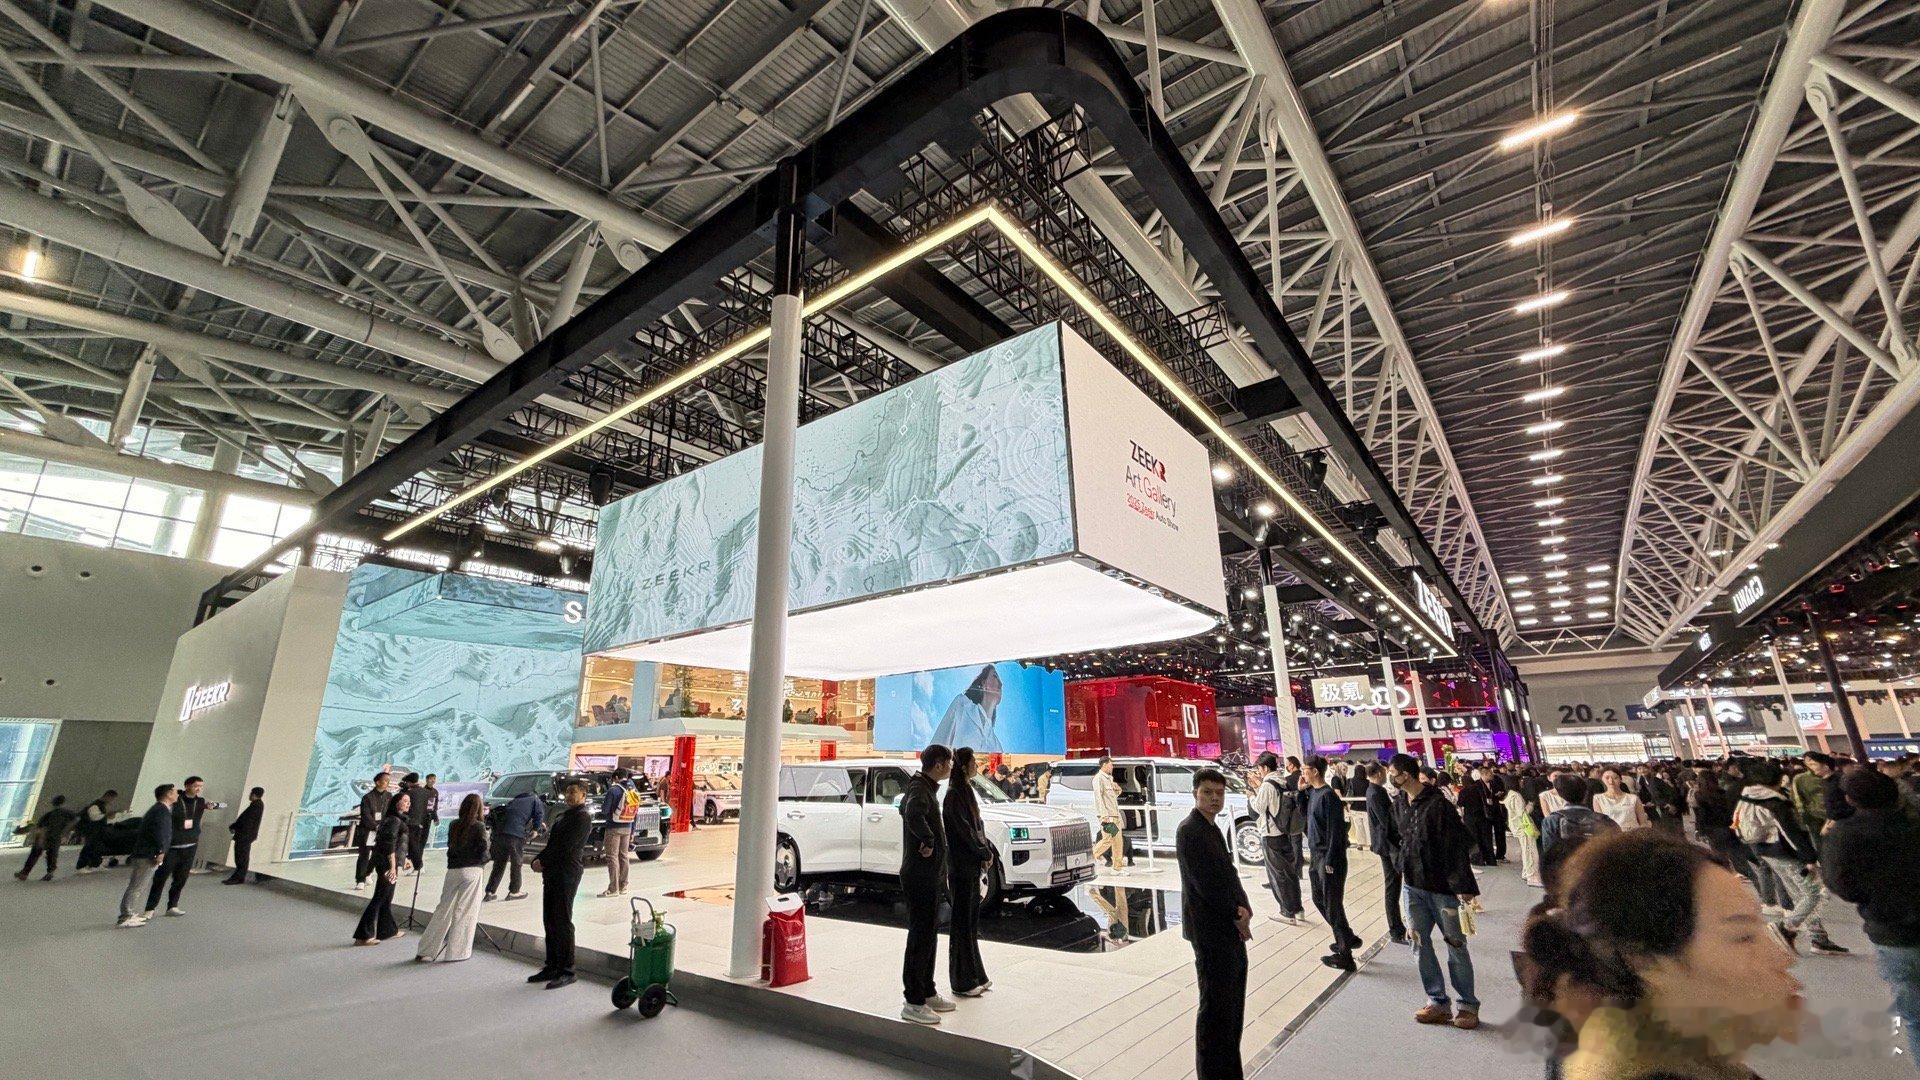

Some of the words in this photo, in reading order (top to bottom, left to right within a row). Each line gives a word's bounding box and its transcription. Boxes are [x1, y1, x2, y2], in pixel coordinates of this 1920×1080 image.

[1129, 439, 1167, 483] ZEEKR
[1125, 464, 1143, 494] Art
[1143, 476, 1176, 518] Gallery
[642, 560, 710, 590] ZEEKR
[1320, 682, 1364, 701] 极氪
[1558, 704, 1618, 724] 20.2
